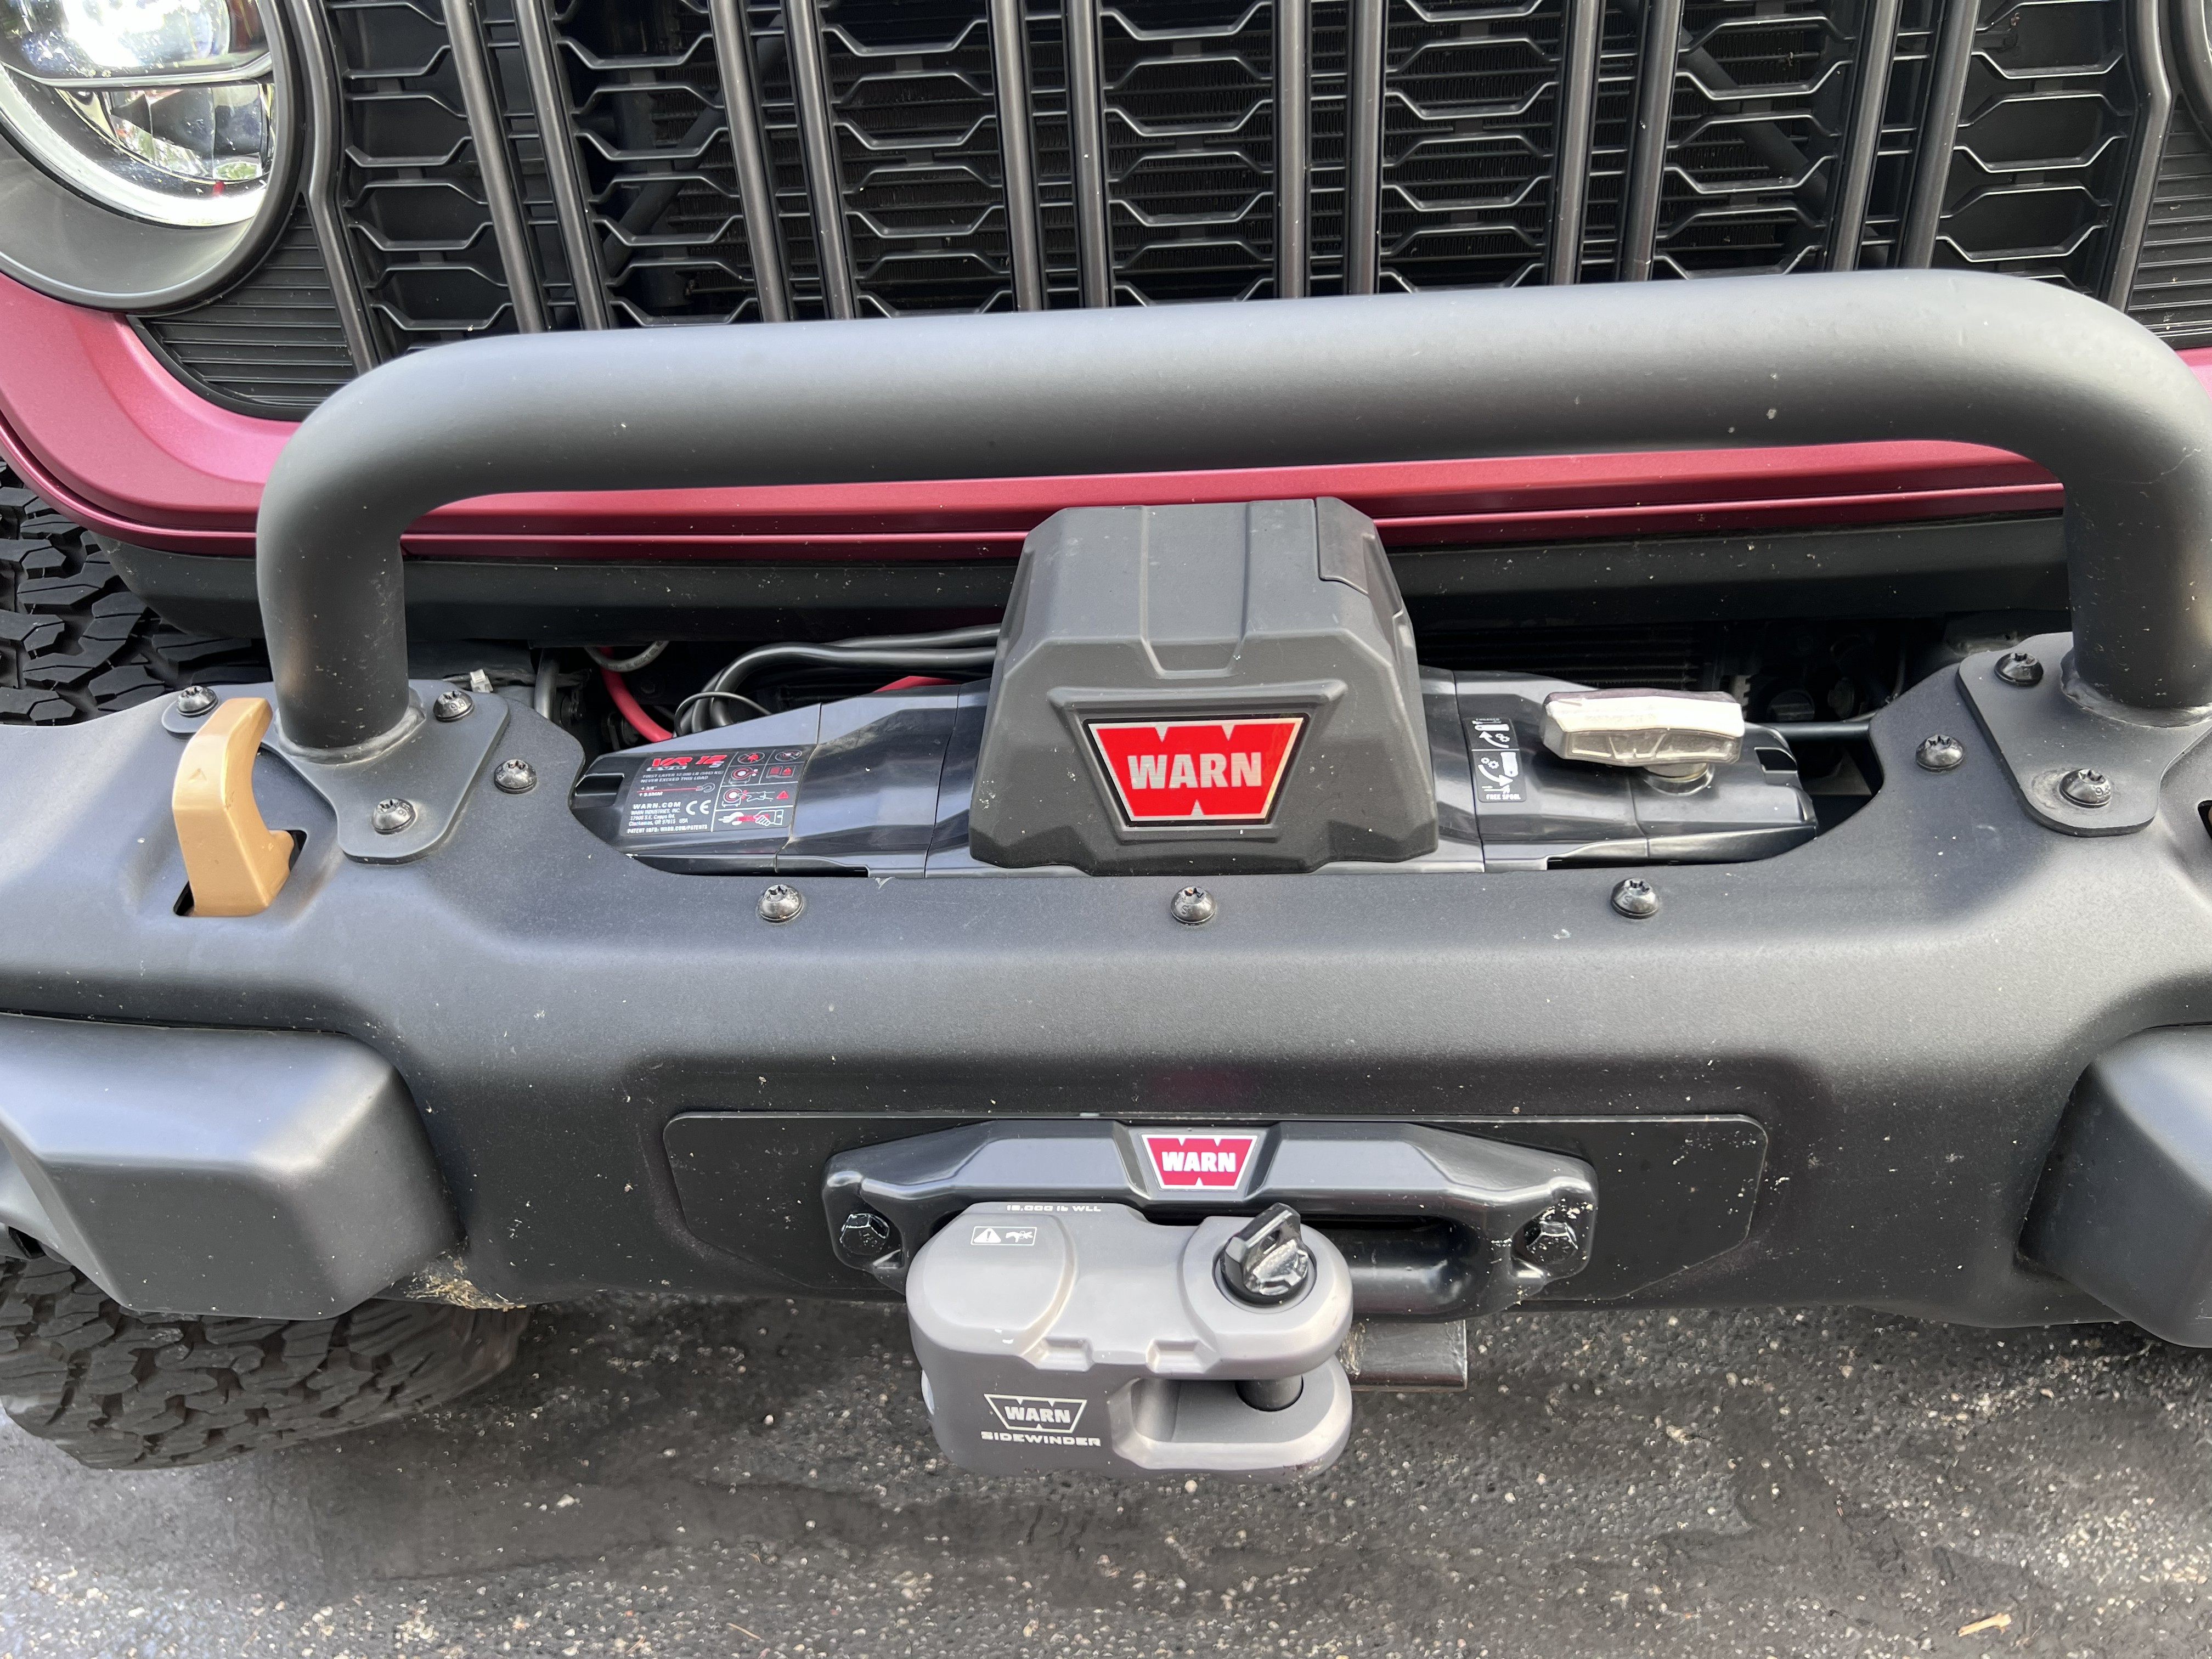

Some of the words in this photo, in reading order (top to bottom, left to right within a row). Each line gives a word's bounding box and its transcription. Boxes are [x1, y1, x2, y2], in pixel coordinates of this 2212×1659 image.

[652, 757, 693, 766] VR
[1127, 752, 1262, 789] WARN
[1161, 1152, 1236, 1172] WARN
[1005, 1406, 1070, 1424] WARN
[980, 1431, 1102, 1447] SIDEWINDER
